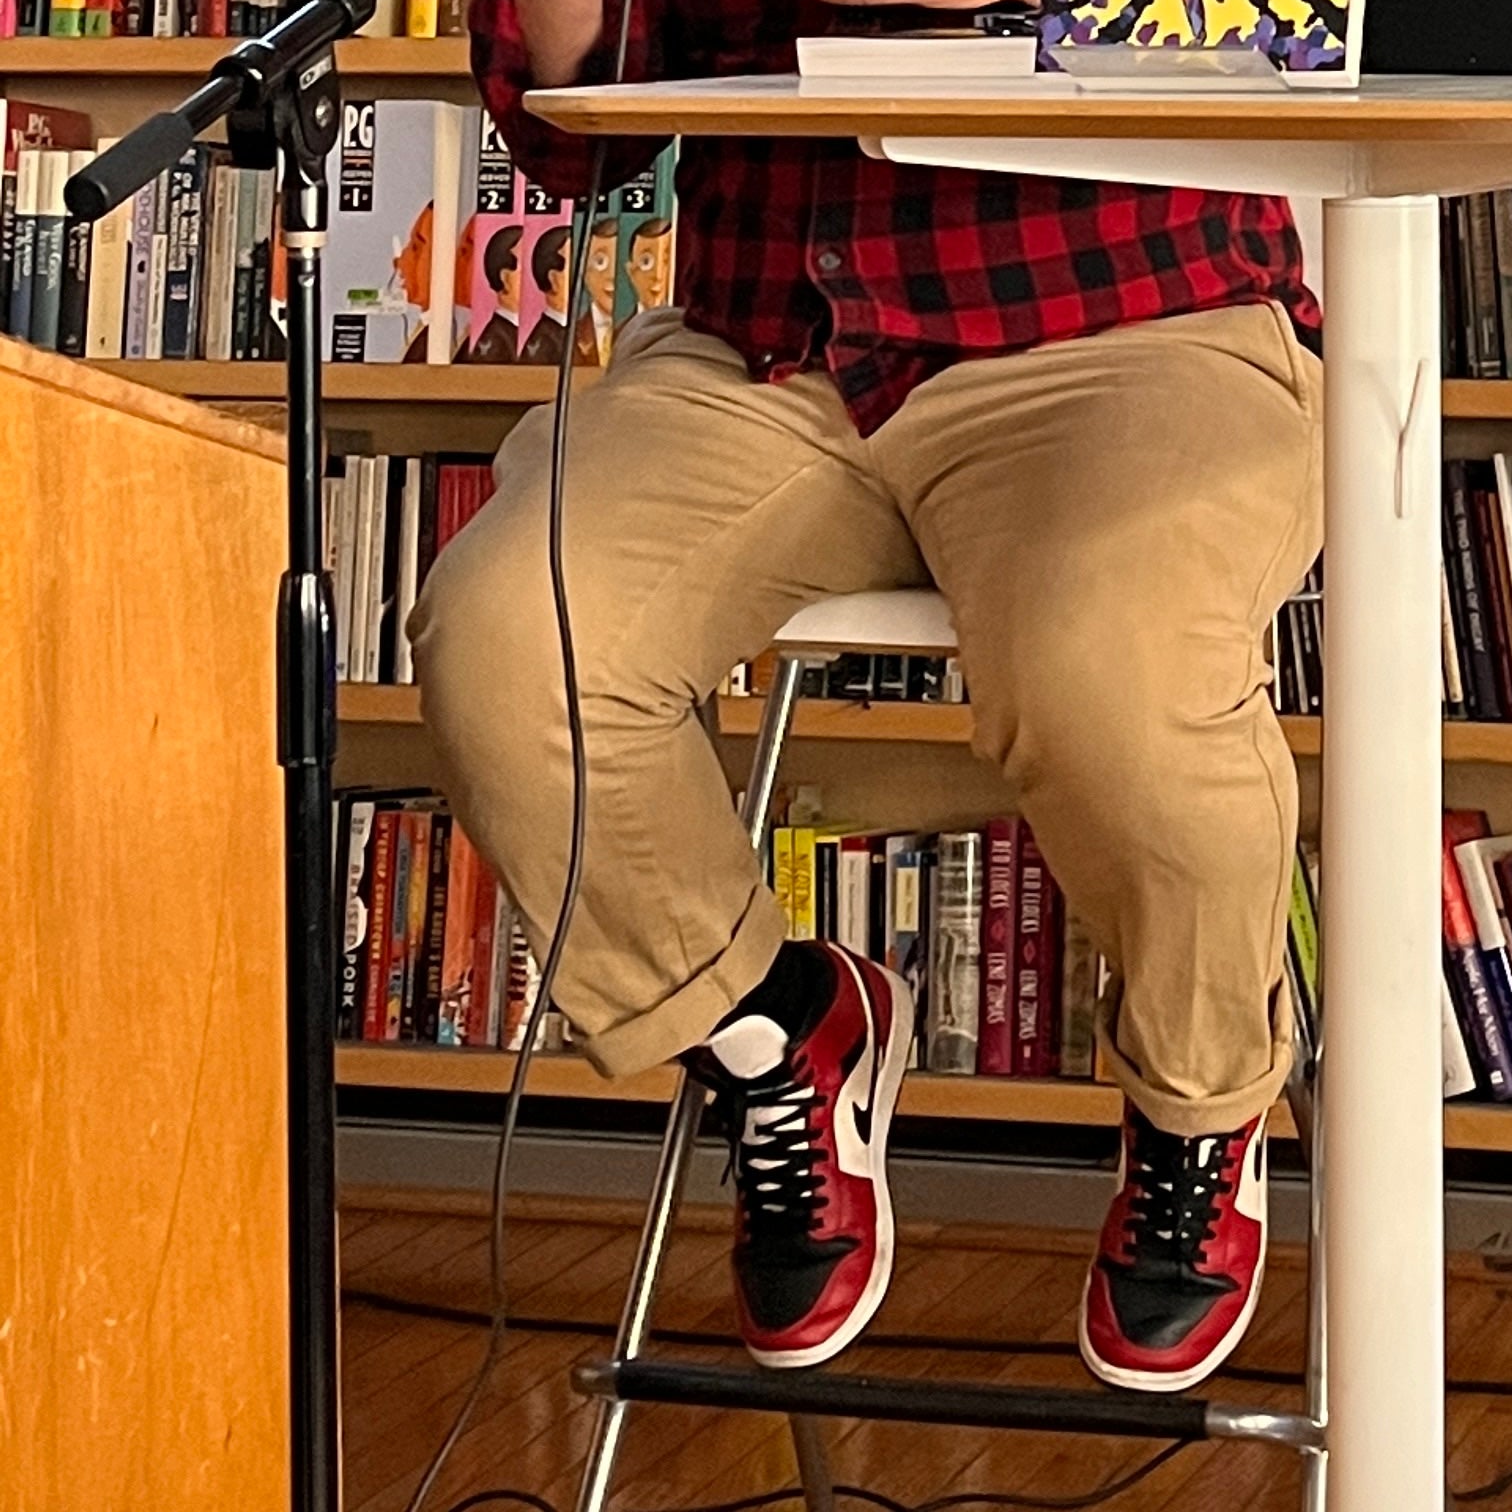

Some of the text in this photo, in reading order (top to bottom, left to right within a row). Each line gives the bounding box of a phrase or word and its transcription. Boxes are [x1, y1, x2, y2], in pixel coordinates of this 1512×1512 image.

[486, 189, 500, 210] 2
[534, 190, 547, 211] 2
[632, 189, 645, 209] 3
[1464, 592, 1480, 610] OF
[1467, 612, 1486, 654] DECAY
[370, 883, 387, 961] CHINATOWN
[985, 839, 1012, 1025] RED CLOCKS LENI ZUMAS
[1017, 866, 1042, 1040] RED CLOCKS LENI ZUMAS
[341, 953, 358, 1008] PORK
